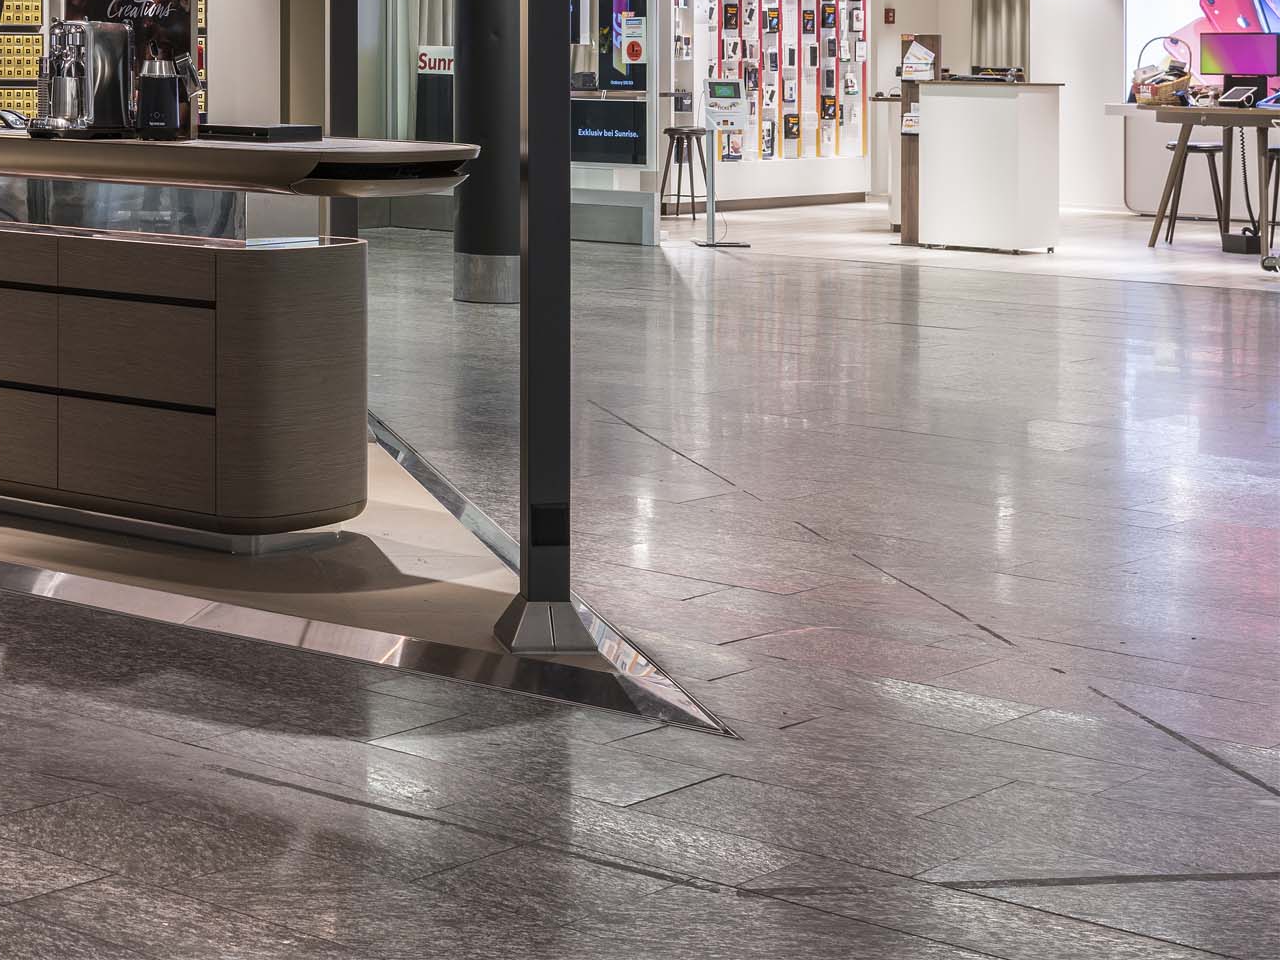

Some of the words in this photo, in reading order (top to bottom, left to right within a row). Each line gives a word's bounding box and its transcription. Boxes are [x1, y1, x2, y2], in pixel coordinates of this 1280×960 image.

[577, 128, 603, 137] Exklusiv
[603, 128, 614, 137] bei
[615, 129, 639, 138] Sunrise.
